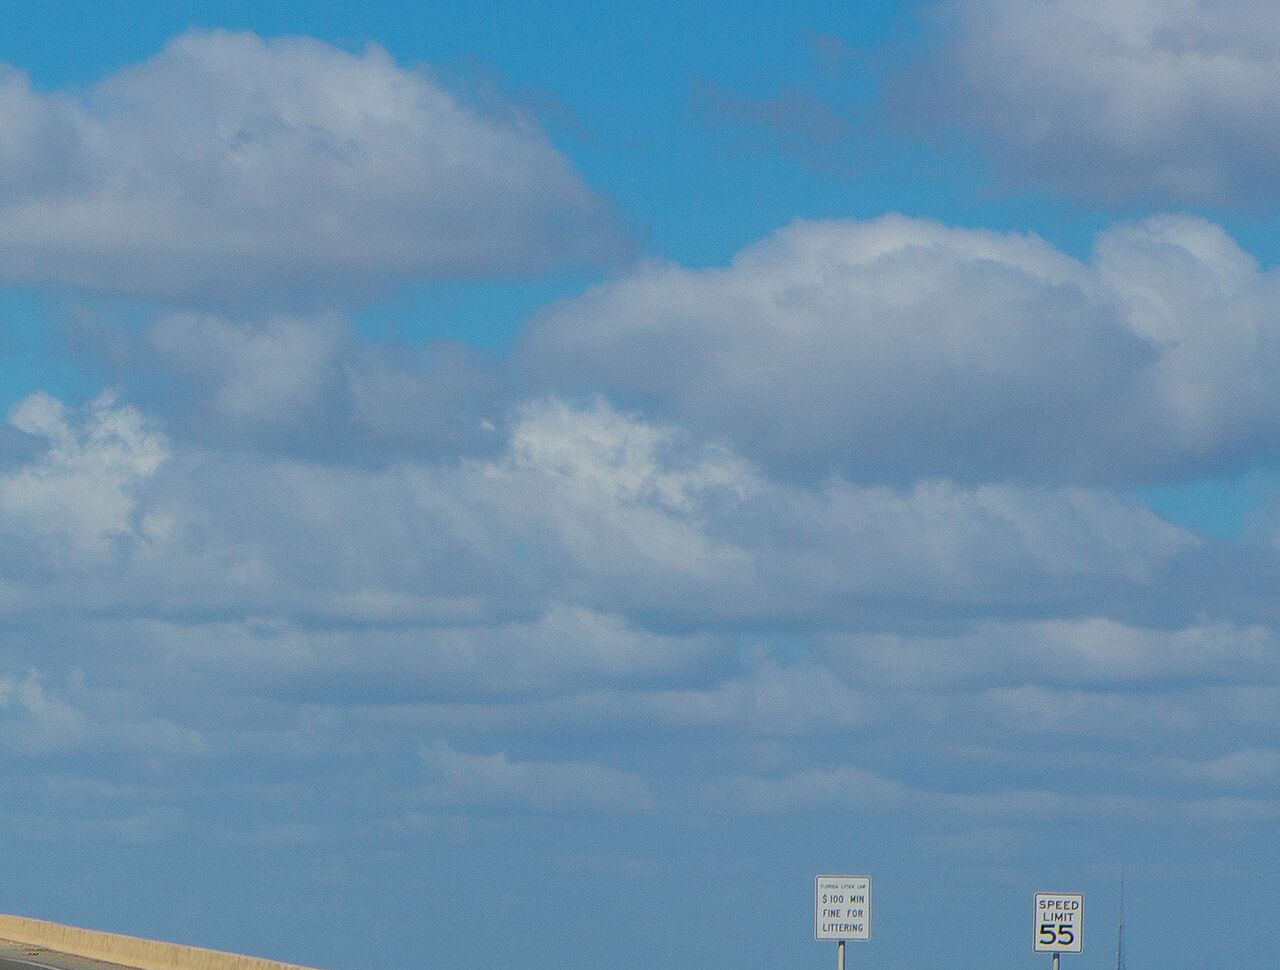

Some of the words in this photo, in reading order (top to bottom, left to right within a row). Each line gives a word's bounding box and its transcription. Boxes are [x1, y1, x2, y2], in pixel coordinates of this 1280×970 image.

[822, 894, 844, 904] $100
[850, 895, 864, 904] MIN
[1039, 900, 1079, 910] SPEED
[823, 909, 841, 918] FINE
[847, 909, 863, 918] FOR
[1043, 912, 1074, 922] LIMIT
[823, 923, 863, 932] LITTERING
[1040, 923, 1074, 945] 55
